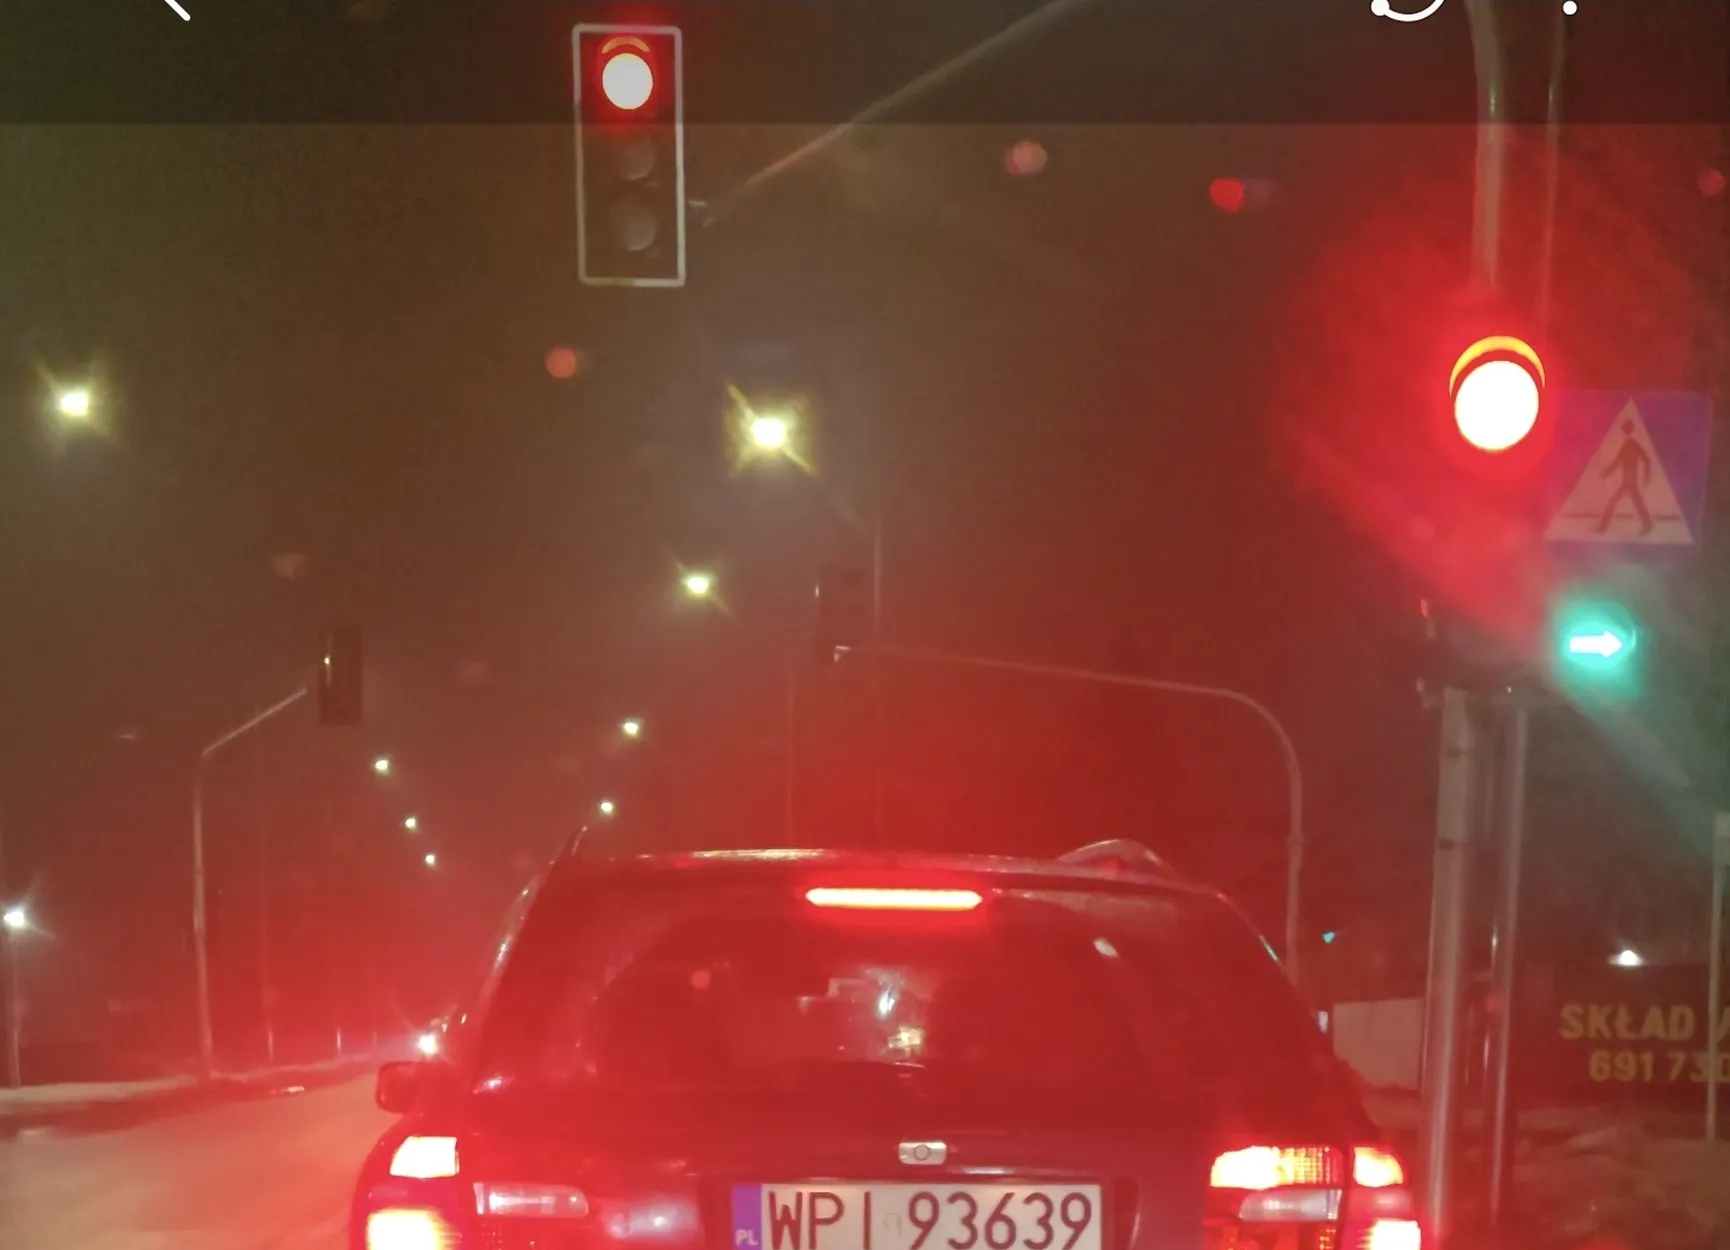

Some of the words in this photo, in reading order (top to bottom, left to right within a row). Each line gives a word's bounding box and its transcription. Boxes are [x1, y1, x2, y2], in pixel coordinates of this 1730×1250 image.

[1560, 1004, 1695, 1040] SKŁAD
[1589, 1050, 1654, 1083] 691
[735, 1229, 758, 1246] PL
[908, 1191, 1093, 1250] 93639
